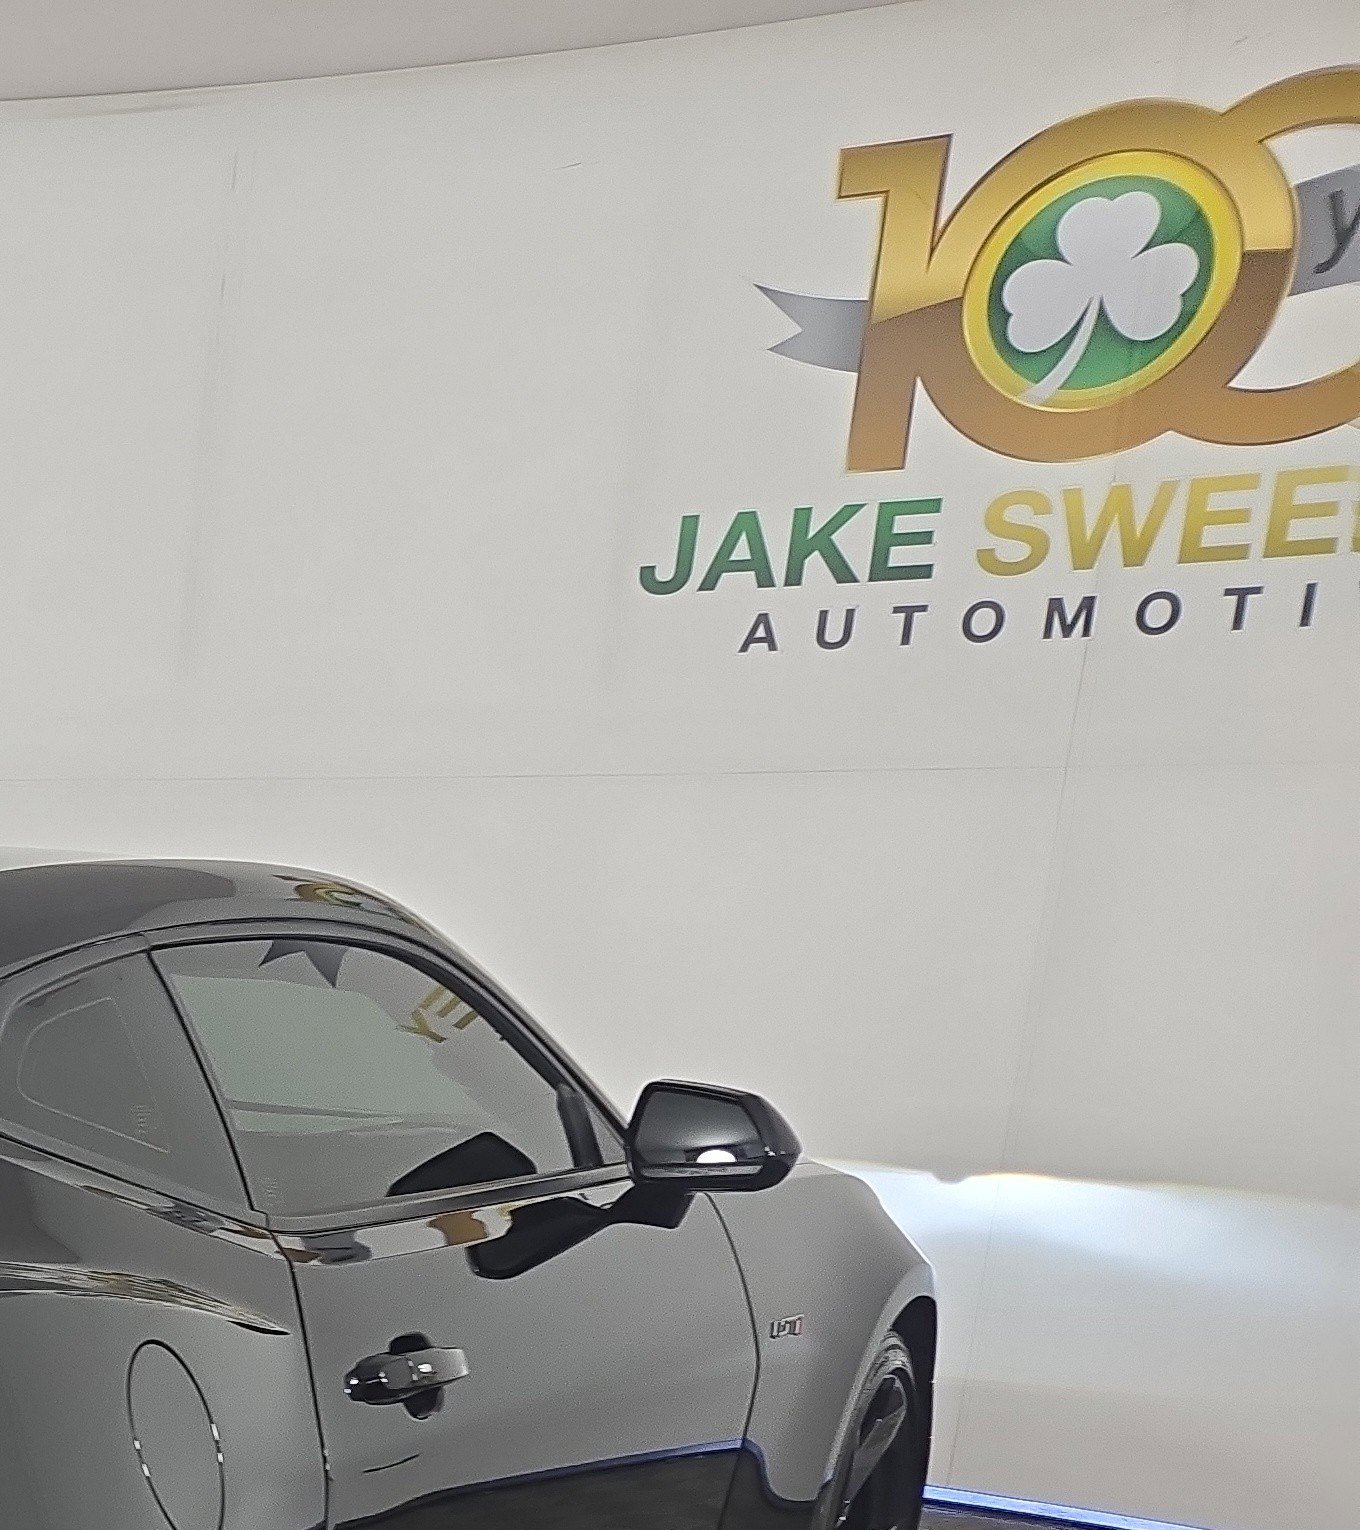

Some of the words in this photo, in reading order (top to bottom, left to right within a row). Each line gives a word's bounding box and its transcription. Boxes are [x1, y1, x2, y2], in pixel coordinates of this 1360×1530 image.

[638, 498, 944, 595] JAKE
[976, 465, 1360, 578] SWEE
[738, 581, 1320, 654] AUTOMOTI
